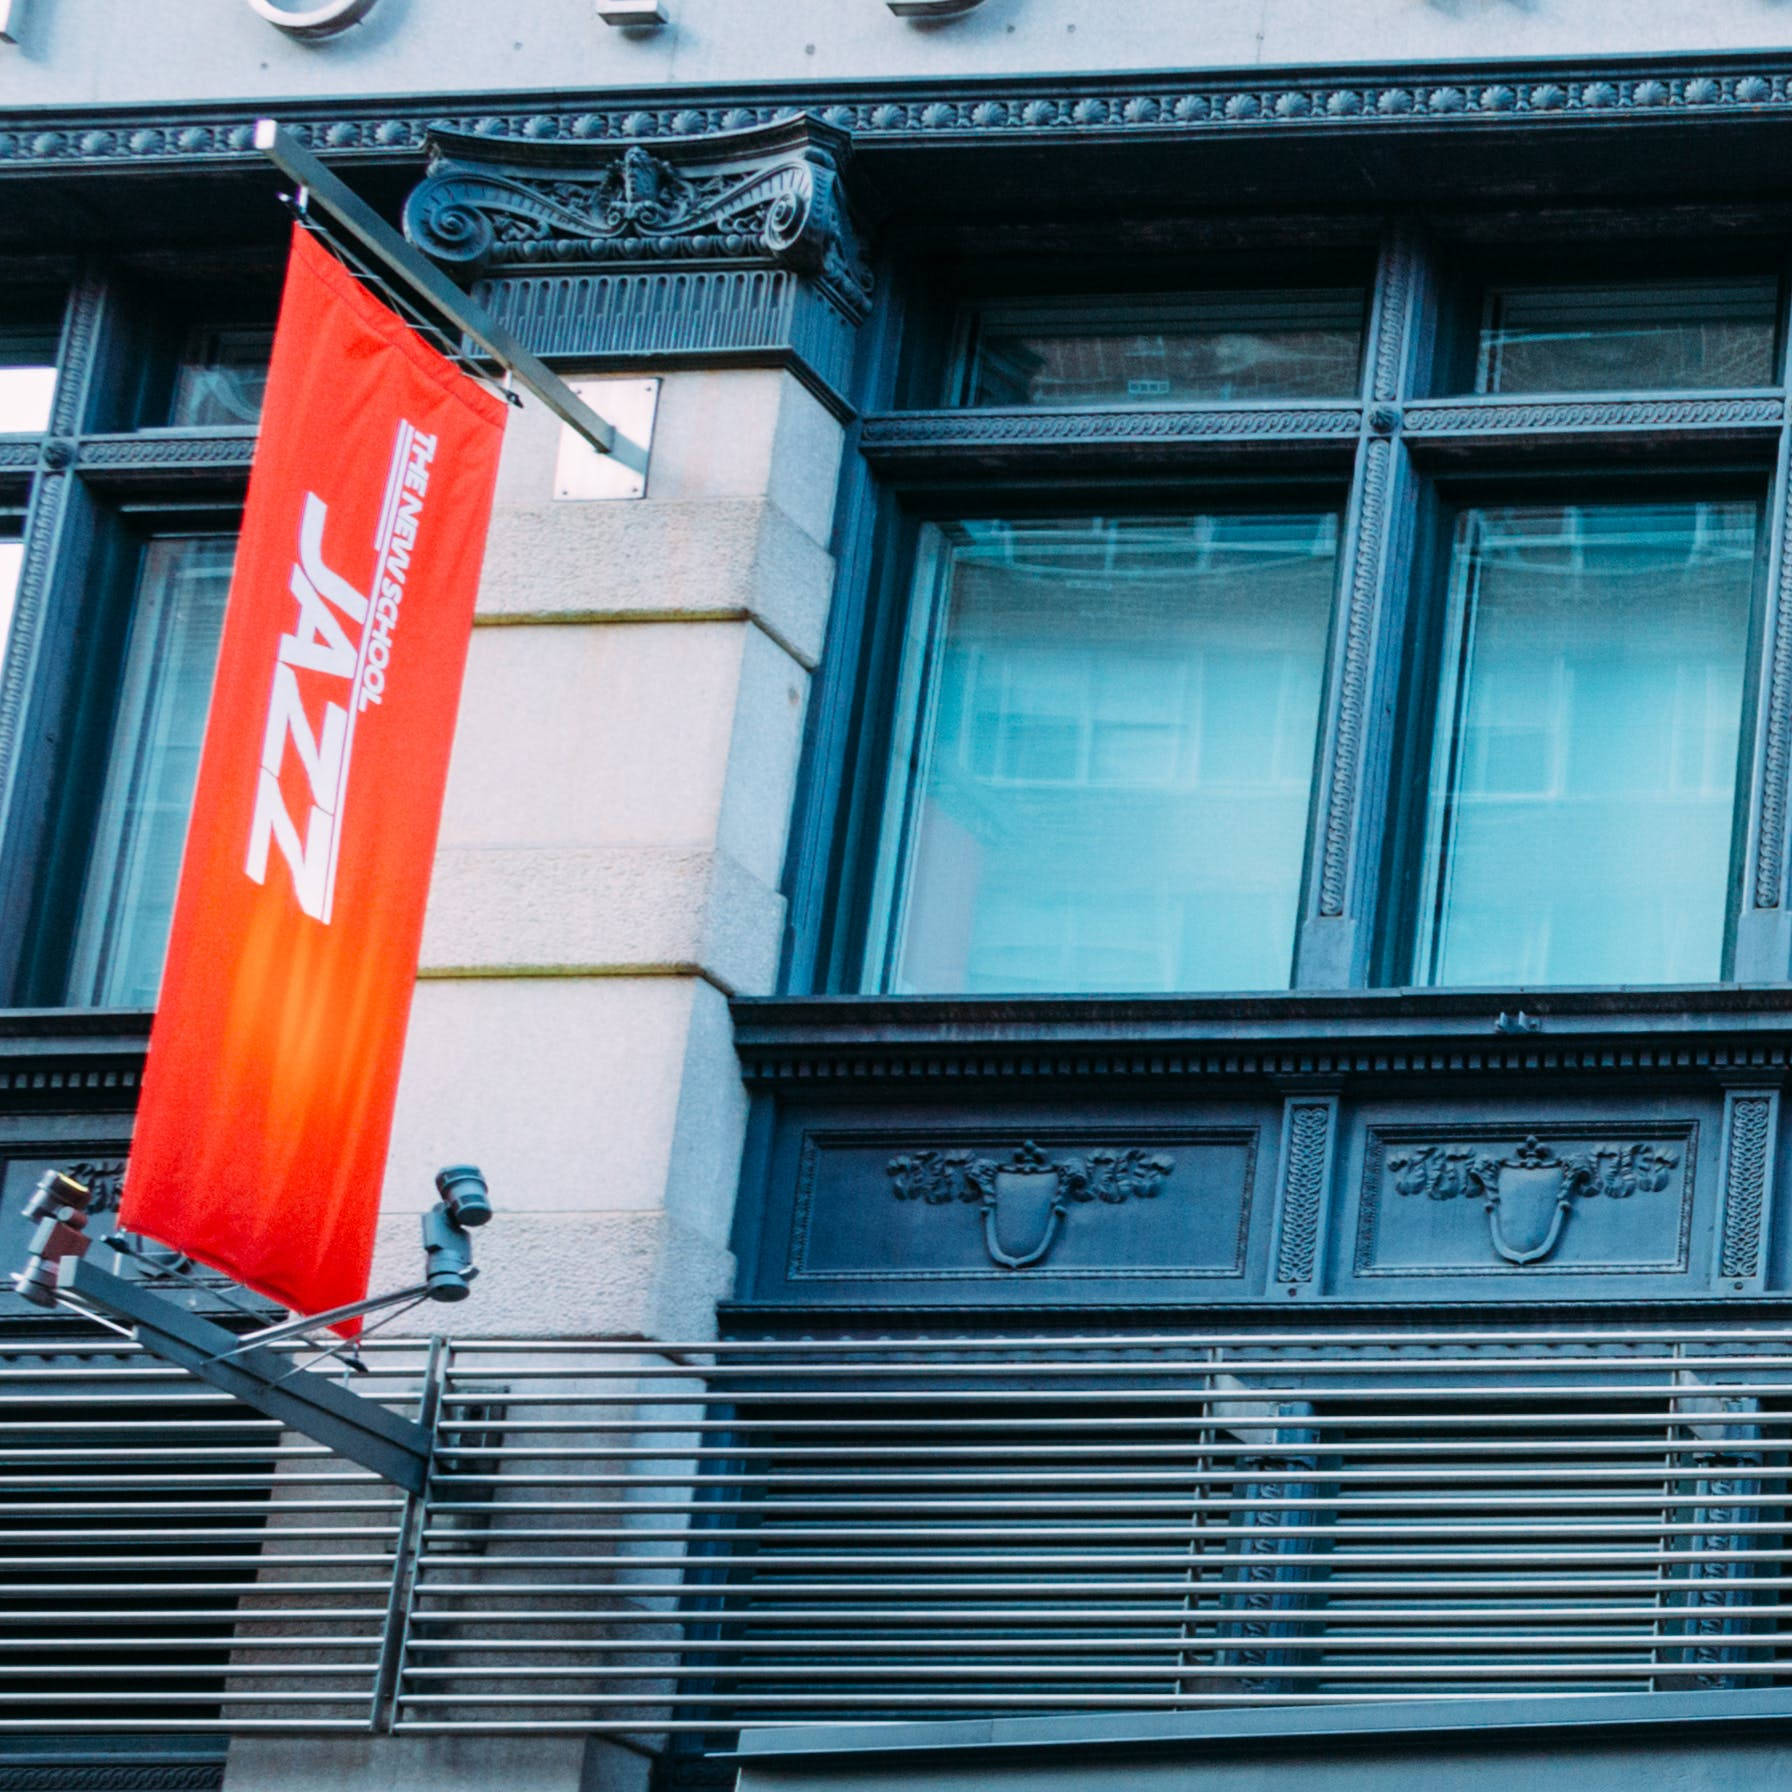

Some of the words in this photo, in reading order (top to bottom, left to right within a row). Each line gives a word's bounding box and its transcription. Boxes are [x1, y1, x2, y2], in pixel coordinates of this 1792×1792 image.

[404, 432, 438, 498] THE
[386, 496, 422, 584] NEW
[357, 583, 407, 713] SCHOOL
[243, 490, 368, 924] JAZZ
